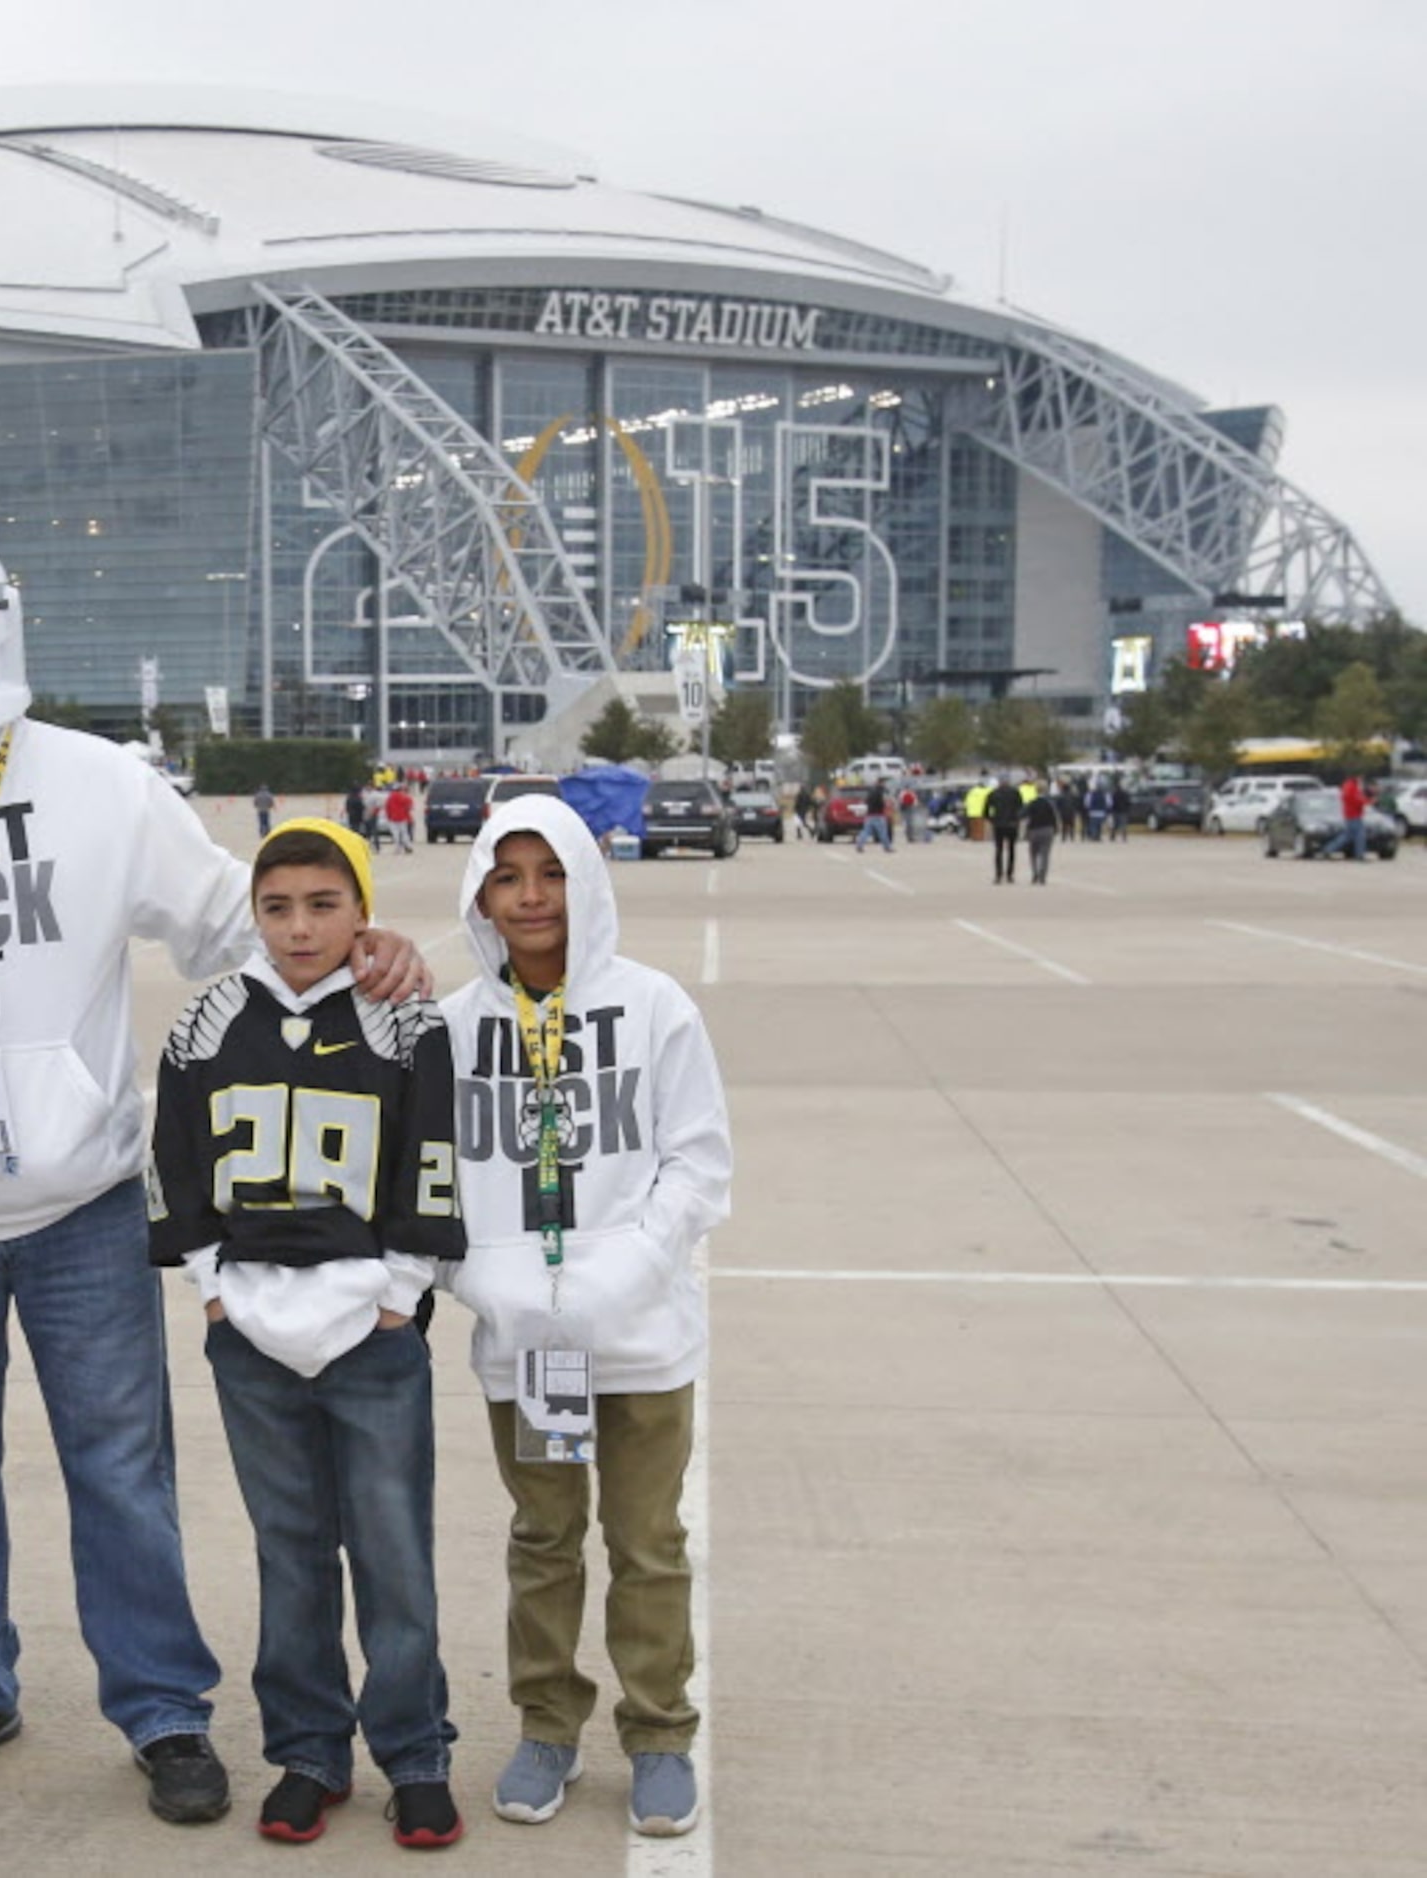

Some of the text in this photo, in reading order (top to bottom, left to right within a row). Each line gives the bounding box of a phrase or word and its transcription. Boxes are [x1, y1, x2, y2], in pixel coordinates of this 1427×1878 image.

[535, 290, 822, 349] AT&T STADIUM
[683, 682, 703, 708] 10
[472, 1006, 624, 1078] JUST
[458, 1067, 642, 1163] DUCK
[417, 1140, 461, 1219] 2
